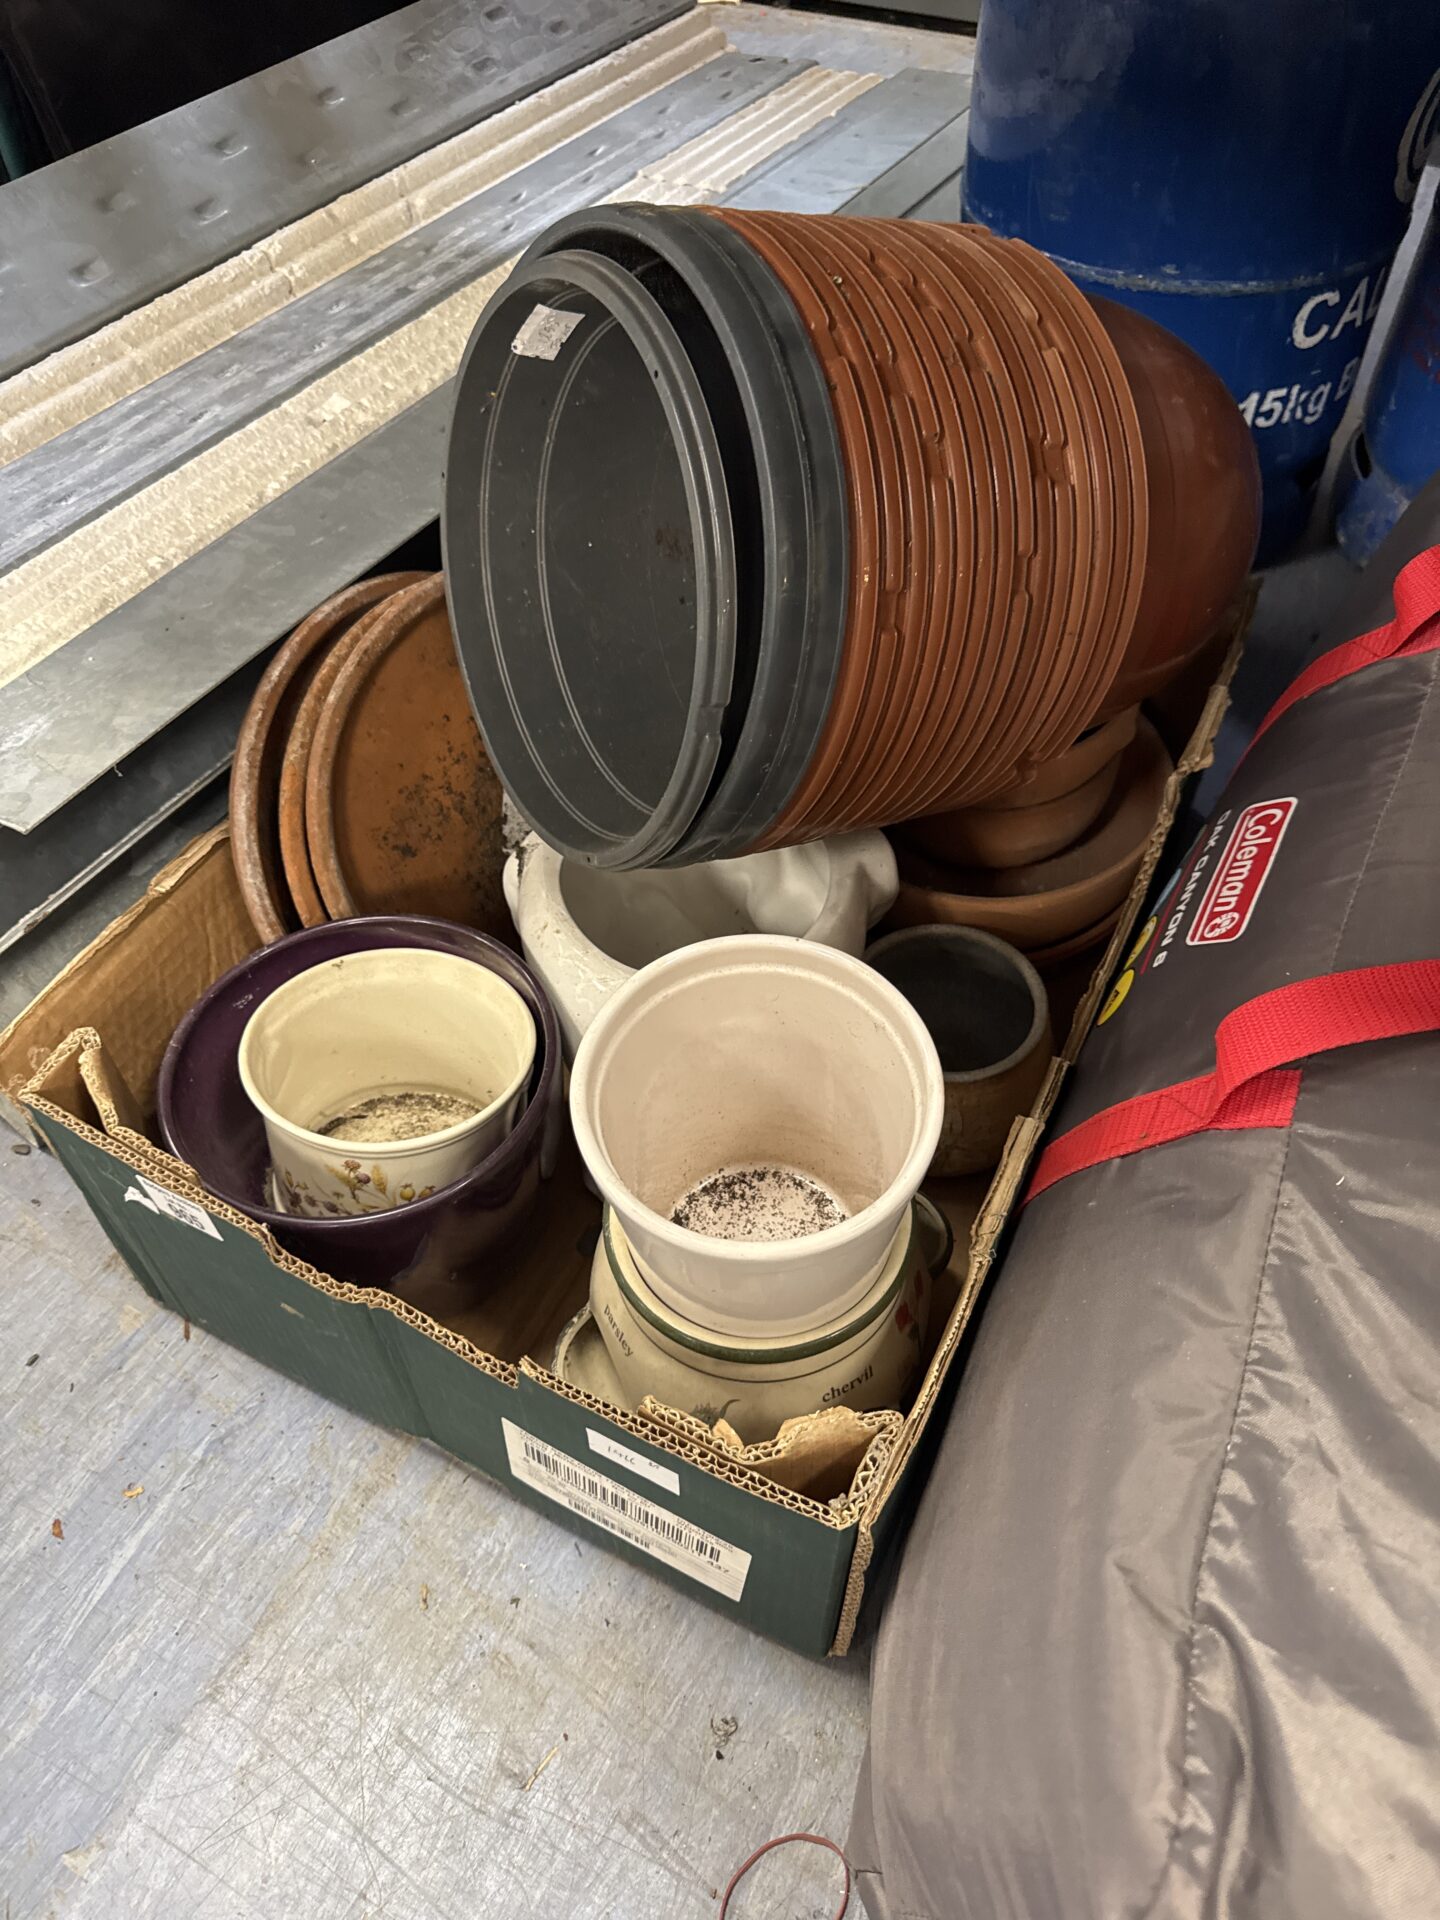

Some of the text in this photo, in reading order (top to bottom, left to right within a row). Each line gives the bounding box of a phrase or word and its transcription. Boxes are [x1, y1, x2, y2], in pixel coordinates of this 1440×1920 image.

[1238, 382, 1332, 428] 15kg
[1202, 809, 1233, 852] OAK
[1213, 808, 1284, 912] Coleman
[1160, 854, 1210, 946] CANYON
[603, 1303, 635, 1357] parsley
[821, 1365, 874, 1404] chervil
